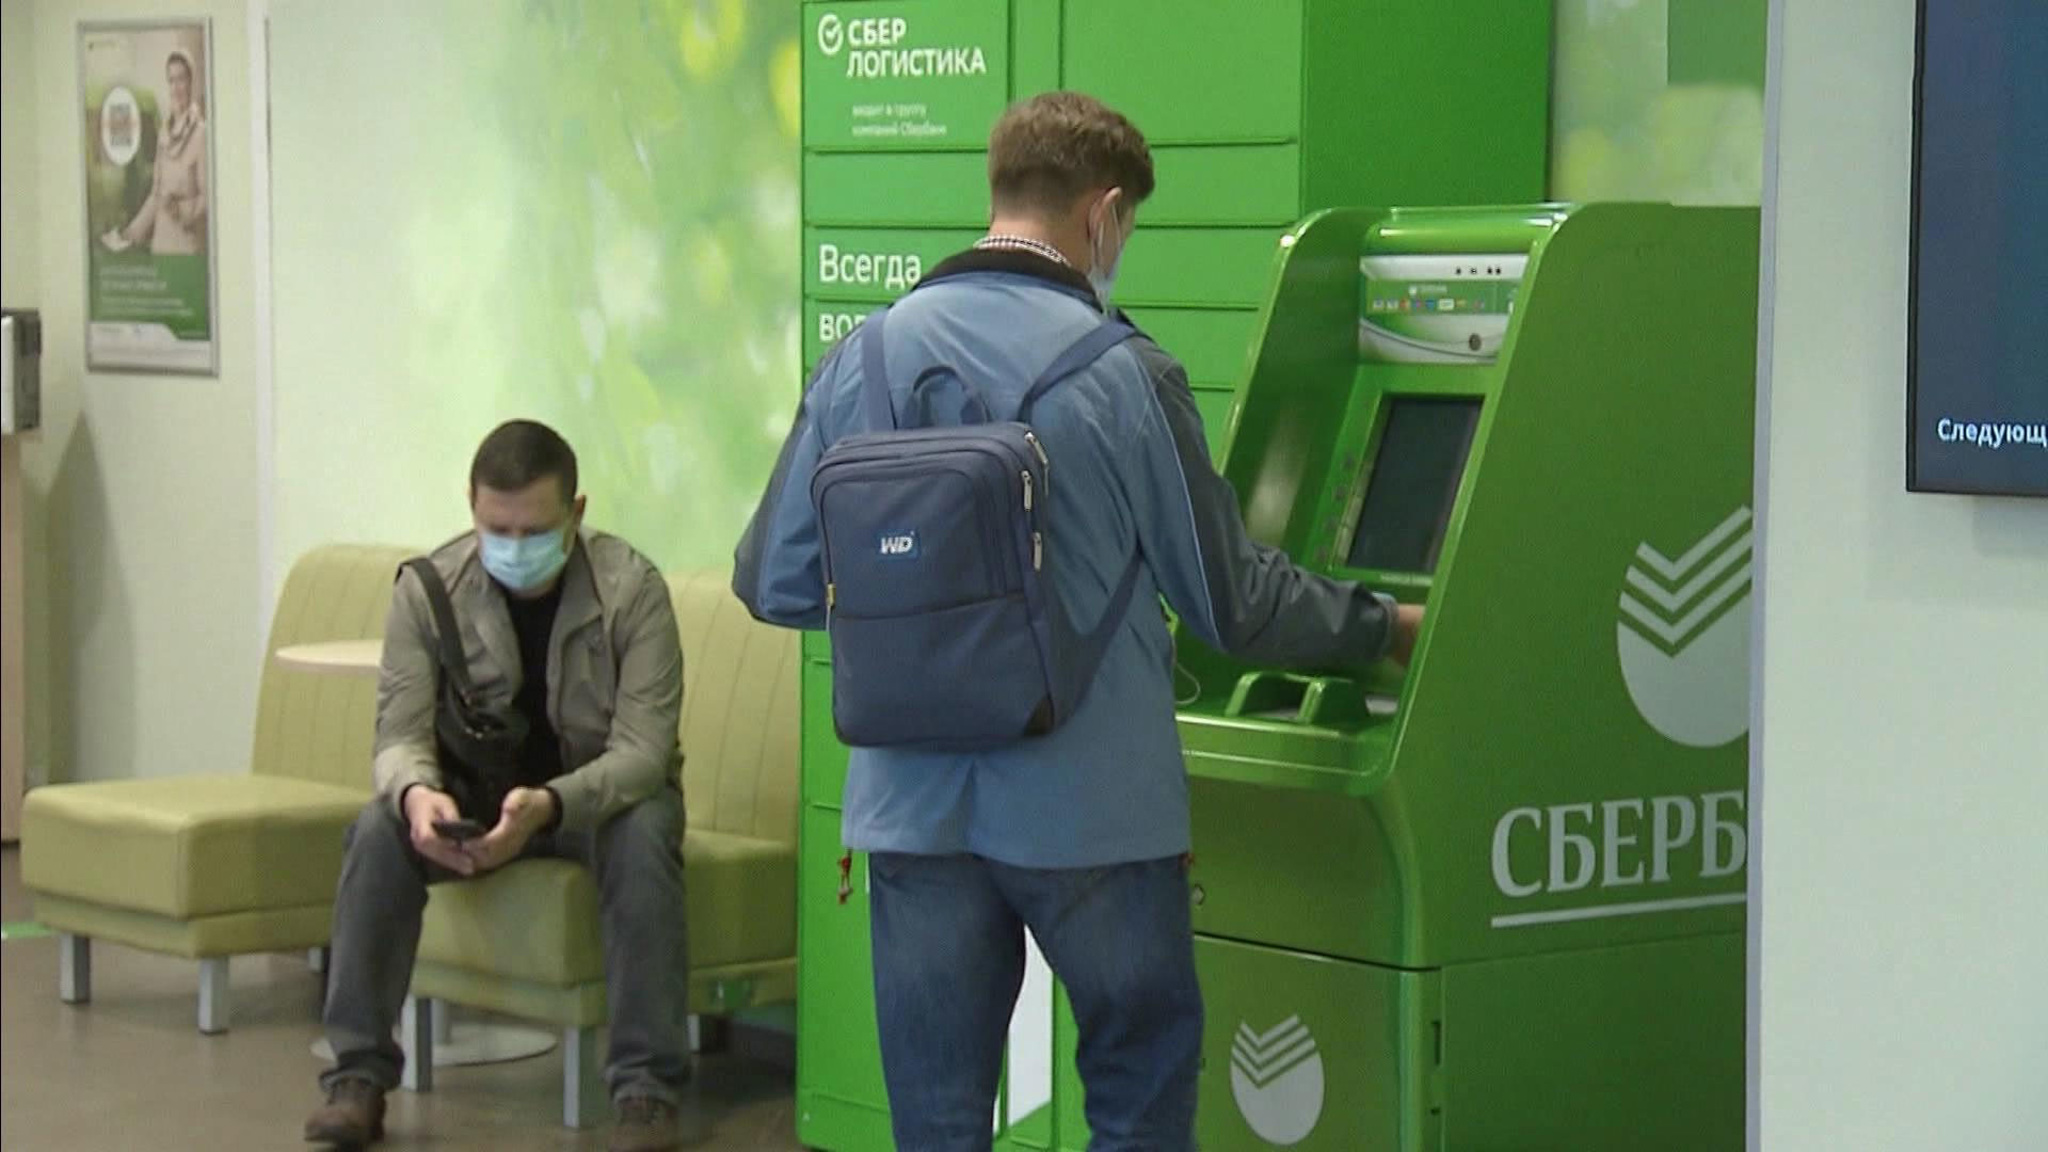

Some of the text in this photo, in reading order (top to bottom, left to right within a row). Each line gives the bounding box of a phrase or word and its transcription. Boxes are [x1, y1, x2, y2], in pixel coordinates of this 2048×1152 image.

[848, 17, 907, 46] СБЕР
[846, 47, 987, 78] ЛОГИСТИКА
[819, 244, 921, 290] Всегда
[819, 313, 867, 341] во
[1938, 418, 2047, 449] Следующ
[881, 536, 913, 554] WD
[1491, 789, 1746, 897] СБЕРБ
